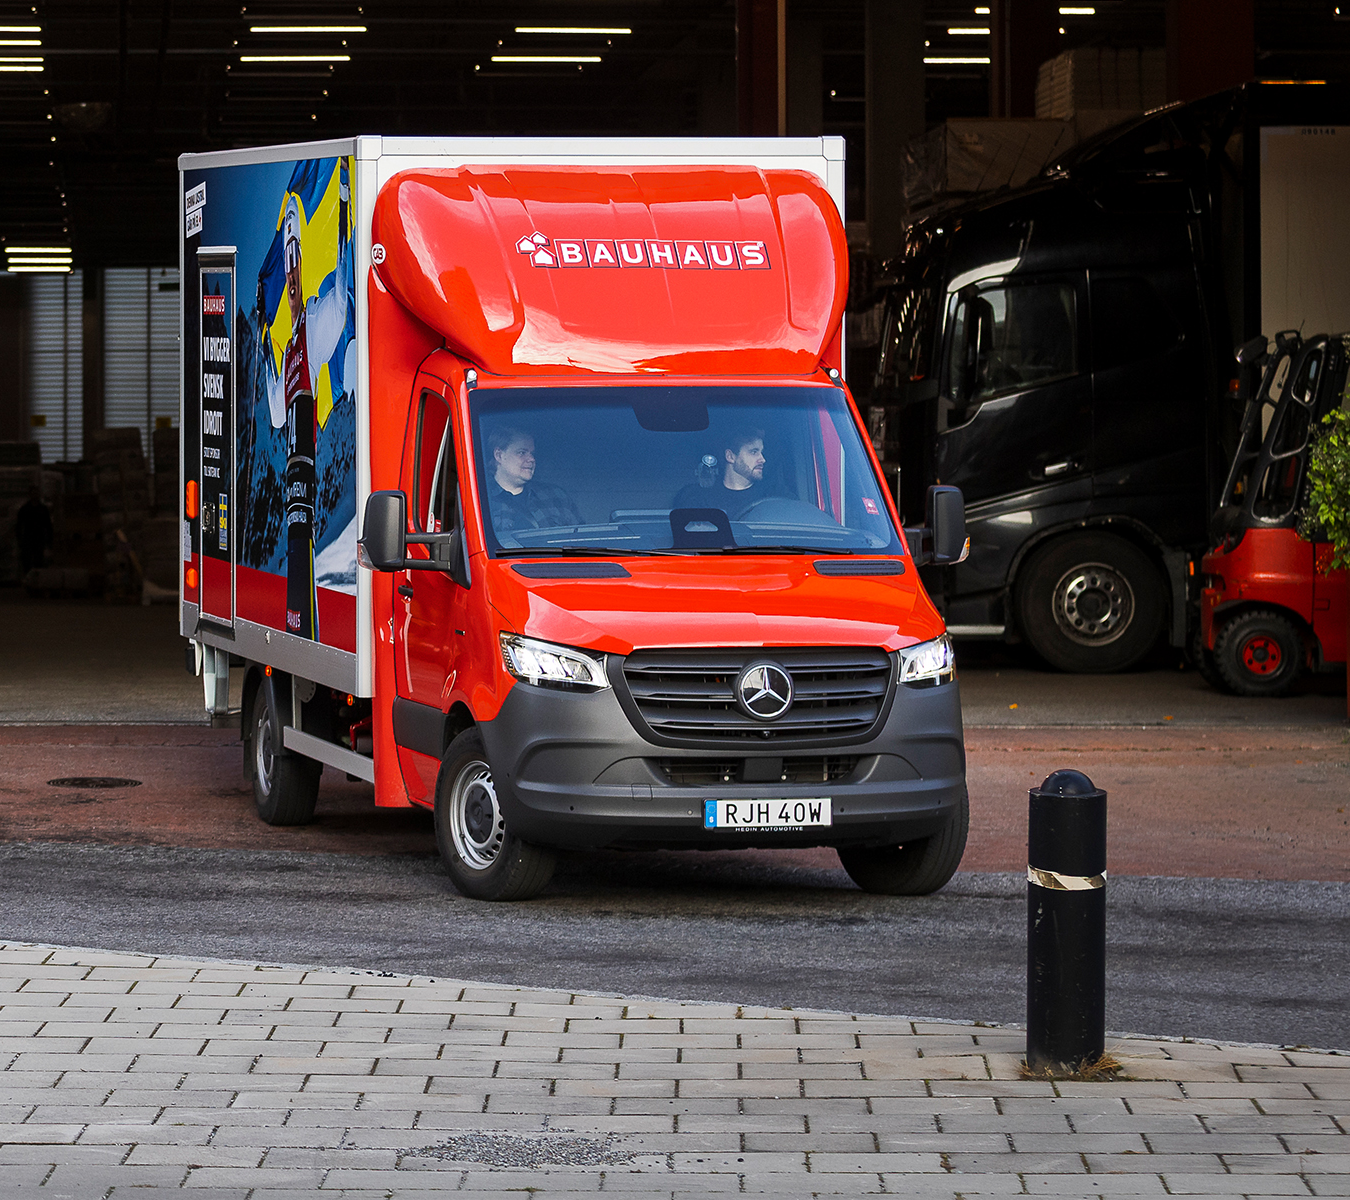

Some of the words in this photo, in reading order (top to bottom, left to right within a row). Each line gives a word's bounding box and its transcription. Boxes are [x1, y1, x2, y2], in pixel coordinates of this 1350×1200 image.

[559, 242, 765, 266] BAUHAUS
[203, 298, 225, 312] BAUHAUS
[203, 337, 209, 361] VI
[210, 337, 230, 362] BYGGER
[203, 373, 224, 399] SVENSK
[203, 410, 223, 437] IDROTT
[287, 402, 297, 457] 24
[726, 803, 769, 824] RJH
[778, 802, 822, 823] 40W
